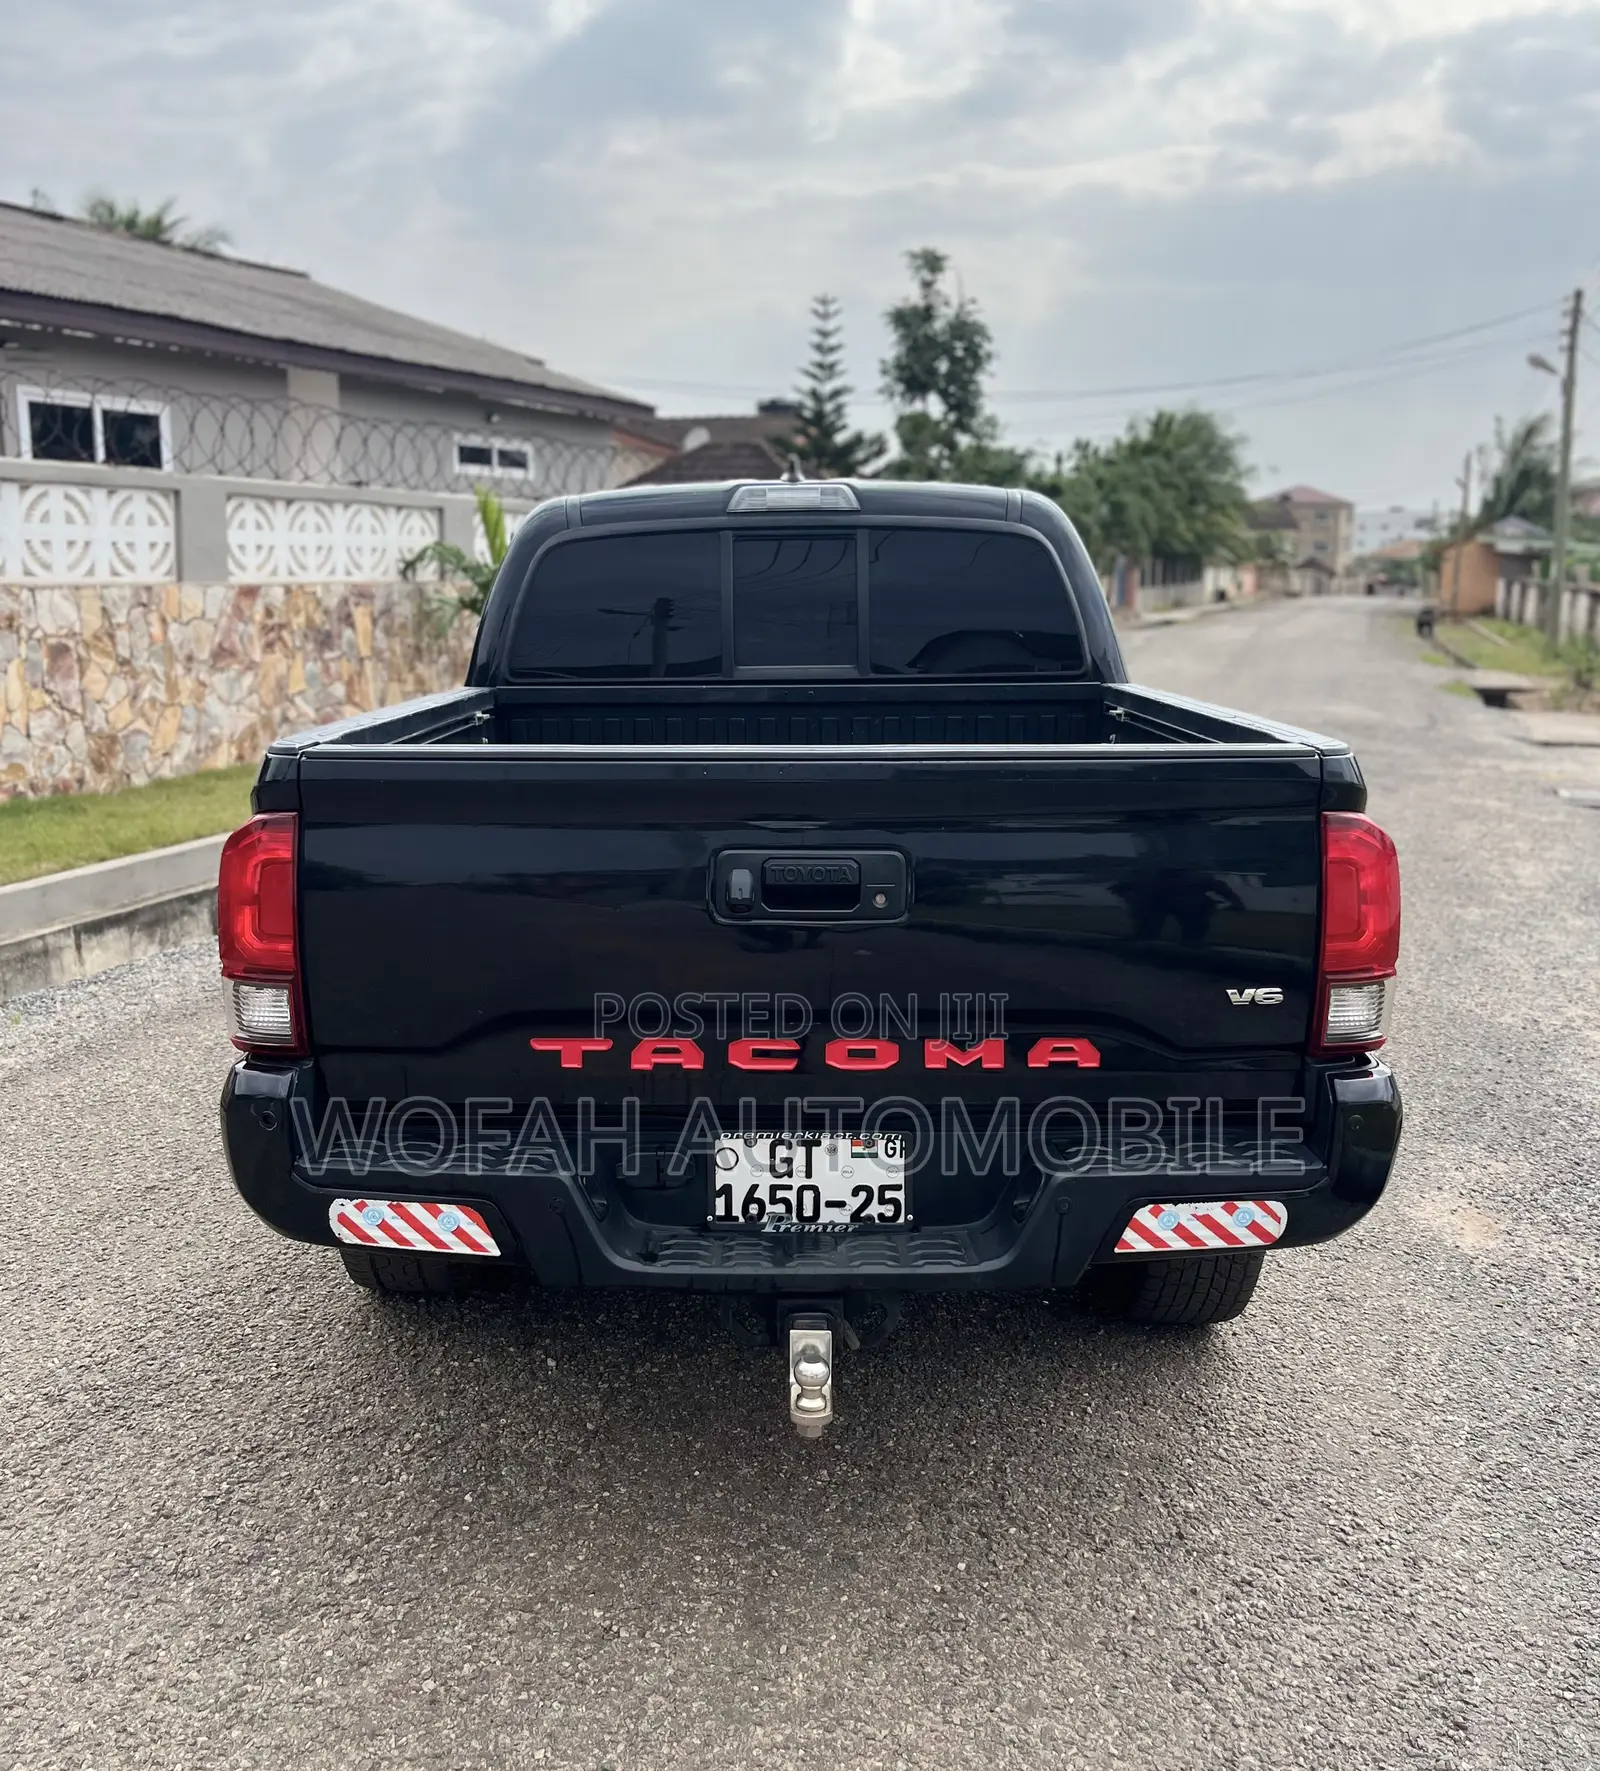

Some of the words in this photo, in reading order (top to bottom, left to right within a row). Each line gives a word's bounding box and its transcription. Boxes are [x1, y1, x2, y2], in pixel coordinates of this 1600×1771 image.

[770, 866, 853, 883] TOYOTA
[1225, 987, 1285, 1005] V6
[530, 1036, 1101, 1071] TACOMA
[769, 1139, 822, 1179] GT
[715, 1183, 903, 1223] 1650-25
[761, 1212, 859, 1233] Premier
